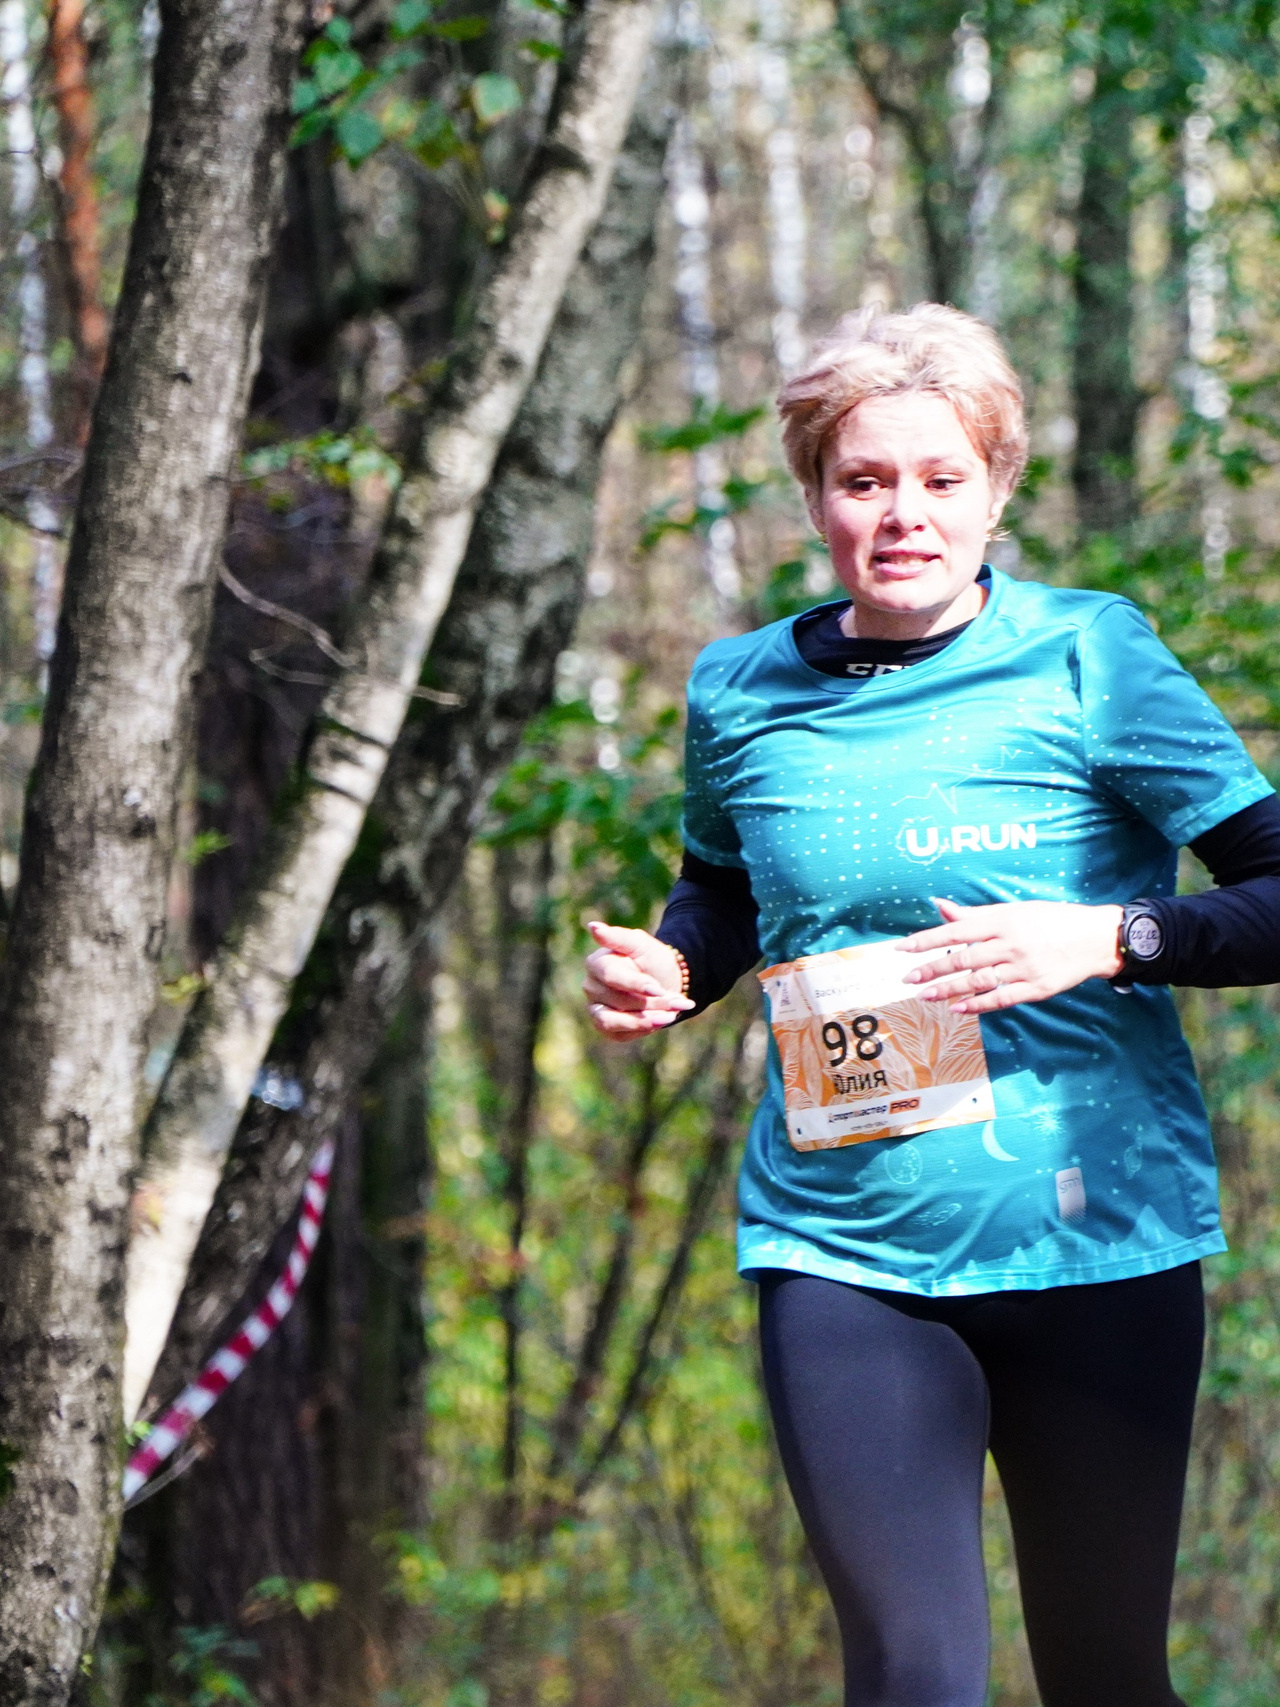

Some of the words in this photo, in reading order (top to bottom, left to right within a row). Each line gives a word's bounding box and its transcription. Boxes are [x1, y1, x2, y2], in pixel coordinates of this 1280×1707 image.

[905, 826, 939, 857] U
[951, 823, 1037, 853] RUN
[822, 1014, 883, 1067] 98
[834, 1069, 888, 1095] Юлия
[890, 1099, 920, 1112] PRO
